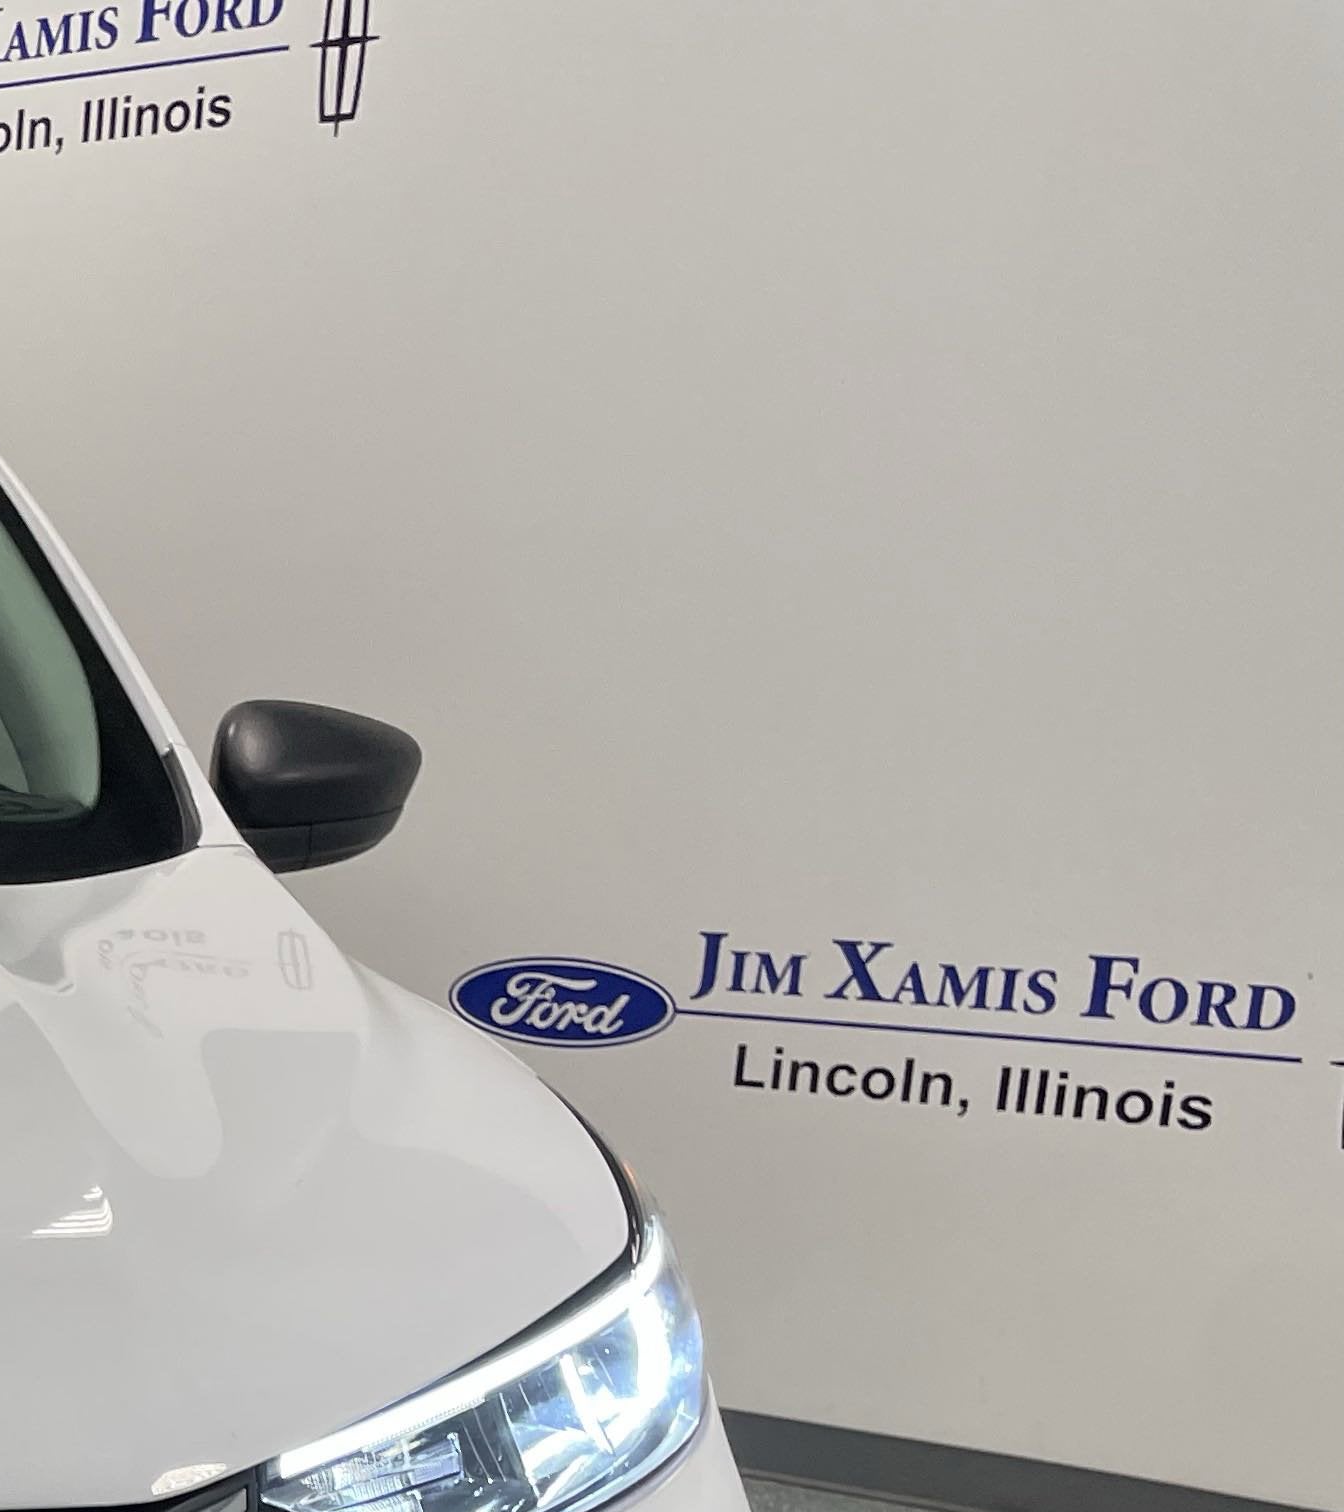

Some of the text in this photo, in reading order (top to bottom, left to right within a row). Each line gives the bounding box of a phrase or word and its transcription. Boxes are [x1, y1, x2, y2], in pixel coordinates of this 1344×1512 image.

[135, 0, 285, 44] FORD
[81, 86, 231, 143] Illinois
[489, 974, 626, 1036] Ford
[689, 930, 1298, 1031] JIM XAMIS FORD
[733, 1043, 1214, 1131] Lincoln, Illinois
